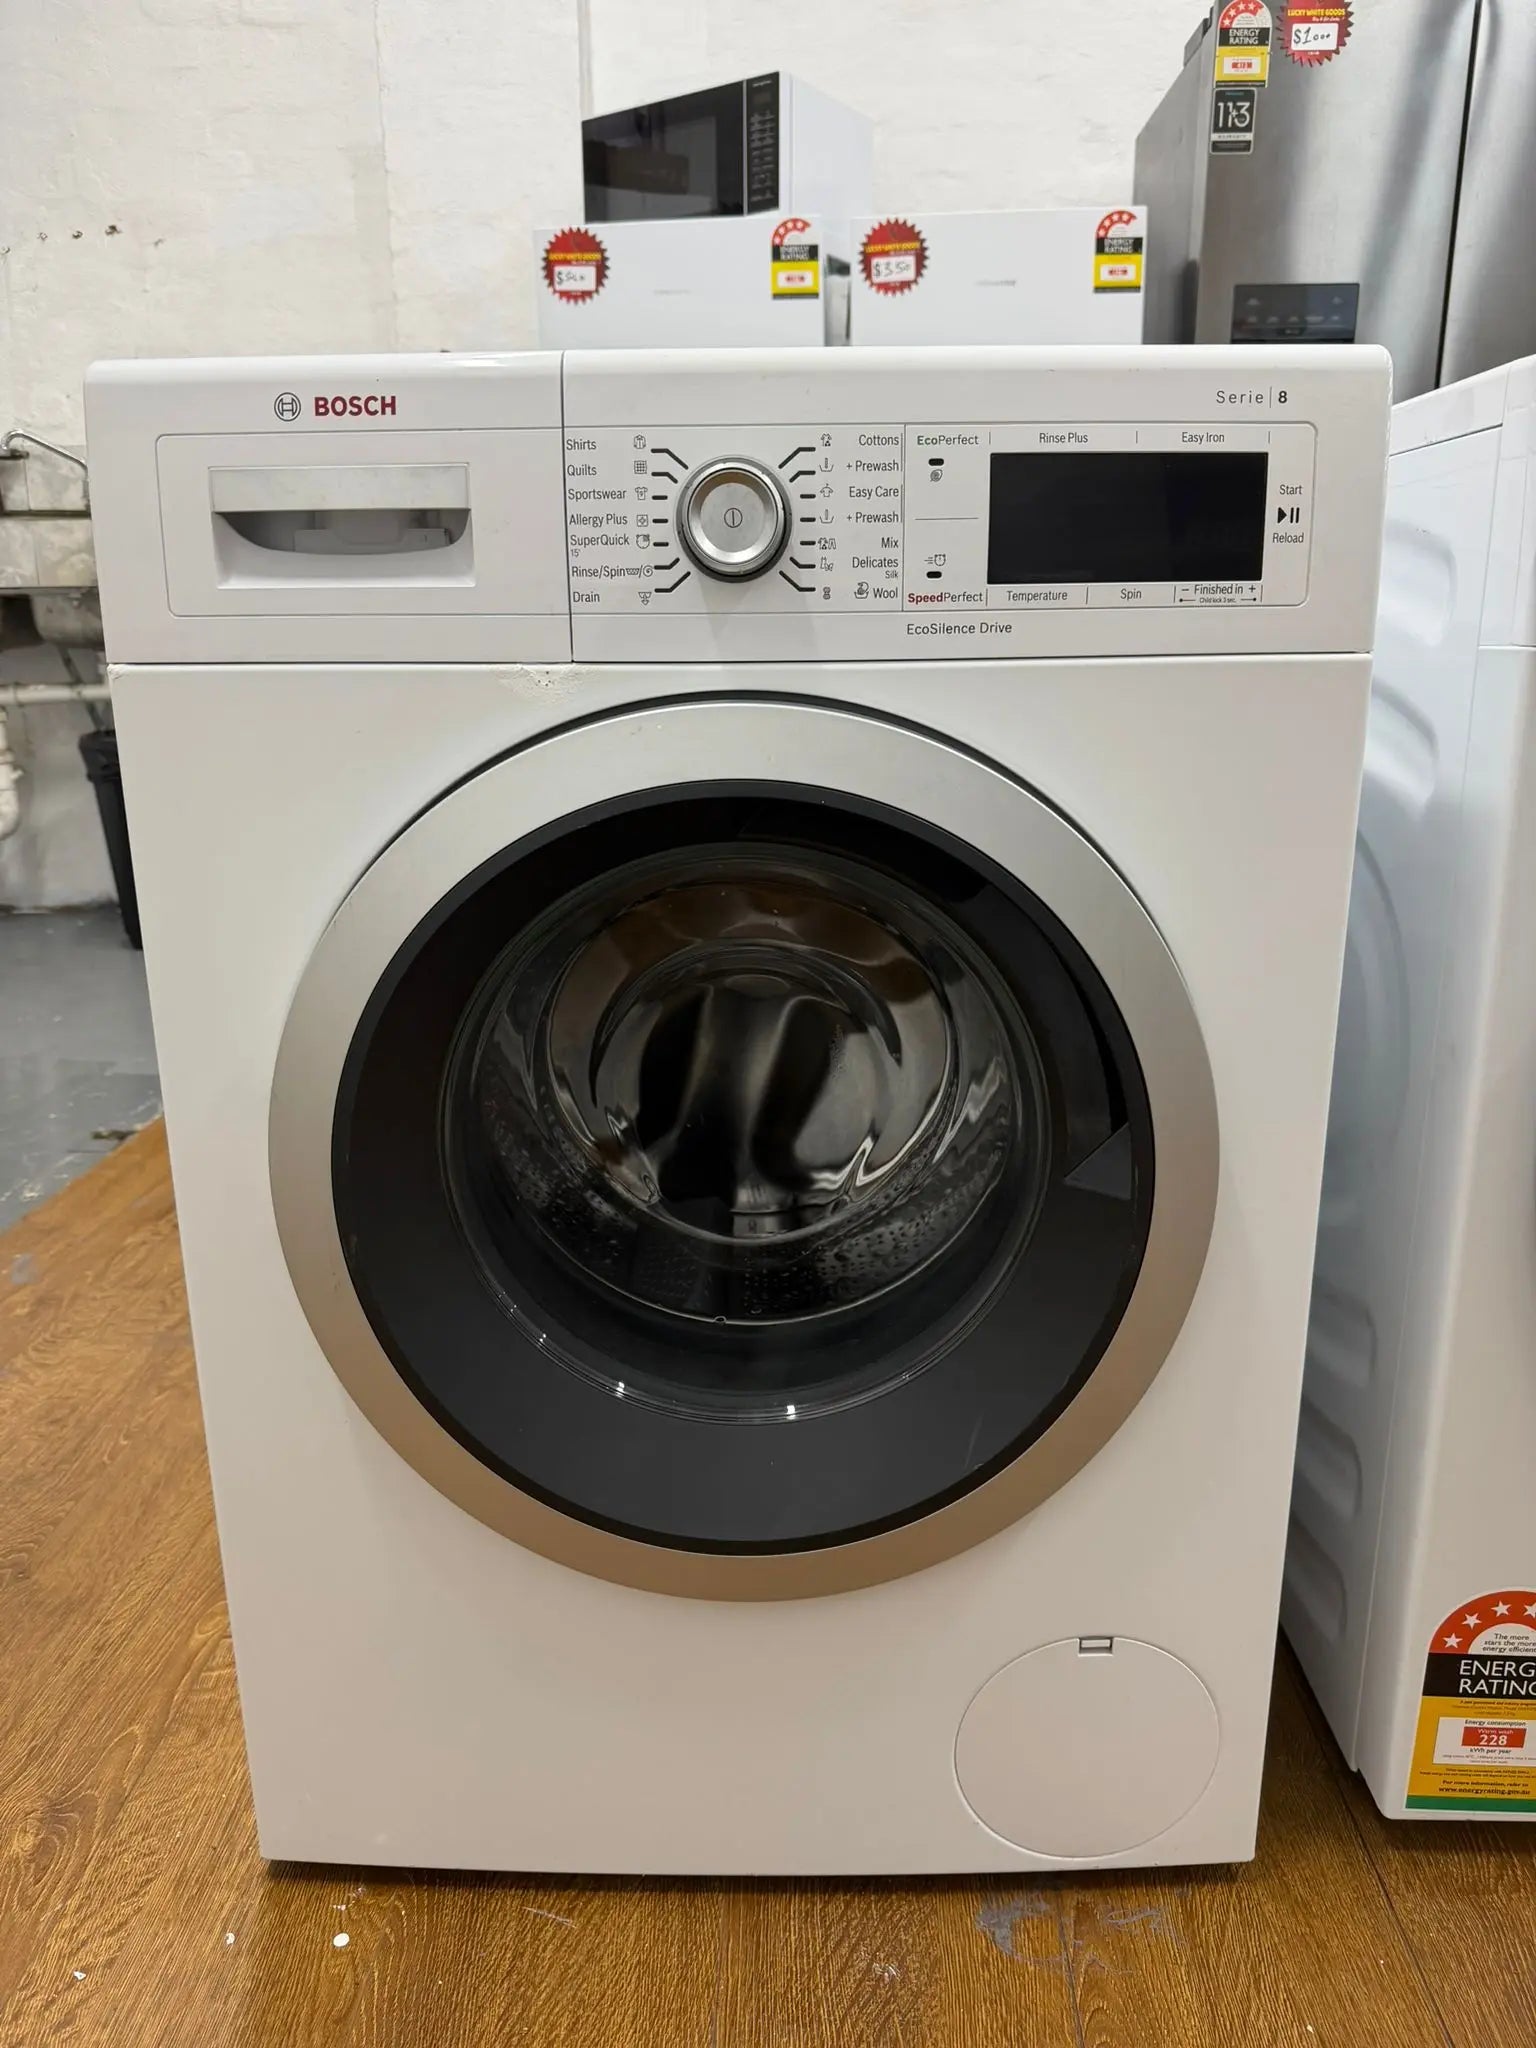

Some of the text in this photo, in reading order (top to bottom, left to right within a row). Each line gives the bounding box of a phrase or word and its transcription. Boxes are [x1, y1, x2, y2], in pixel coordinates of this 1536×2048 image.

[1229, 37, 1259, 45] RATING
[1216, 390, 1288, 404] Serie 8
[314, 396, 396, 417] BOSCH
[859, 434, 899, 446] Cottons
[917, 434, 979, 446] EcoPerfect
[1039, 432, 1088, 443] Rinse Plus
[1182, 432, 1225, 444] Easy Iron
[566, 439, 597, 450] Shirts
[567, 464, 597, 476] Quilts
[855, 459, 899, 472] Prewash
[568, 488, 627, 502] Sportswear
[849, 485, 899, 500] Easy Care
[1279, 484, 1303, 495] Start
[569, 513, 628, 528] Allergy Plus
[855, 511, 899, 523] Prewash
[570, 534, 630, 548] SuperQuick
[881, 537, 899, 548] Mix
[1272, 532, 1304, 543] Reload
[852, 556, 899, 568] Delicates
[572, 565, 626, 579] Rinse/Spin
[885, 570, 898, 579] Silk
[873, 587, 898, 599] Wool
[1120, 588, 1142, 600] Spin
[1194, 584, 1233, 594] Finished
[1235, 584, 1243, 594] in
[573, 591, 600, 602] Drain
[908, 591, 983, 605] SpeedPerfect
[1006, 590, 1068, 603] Temperature
[906, 622, 1012, 635] EcoSilence Drive
[1459, 1660, 1536, 1677] ENERG
[1479, 1735, 1507, 1746] 228
